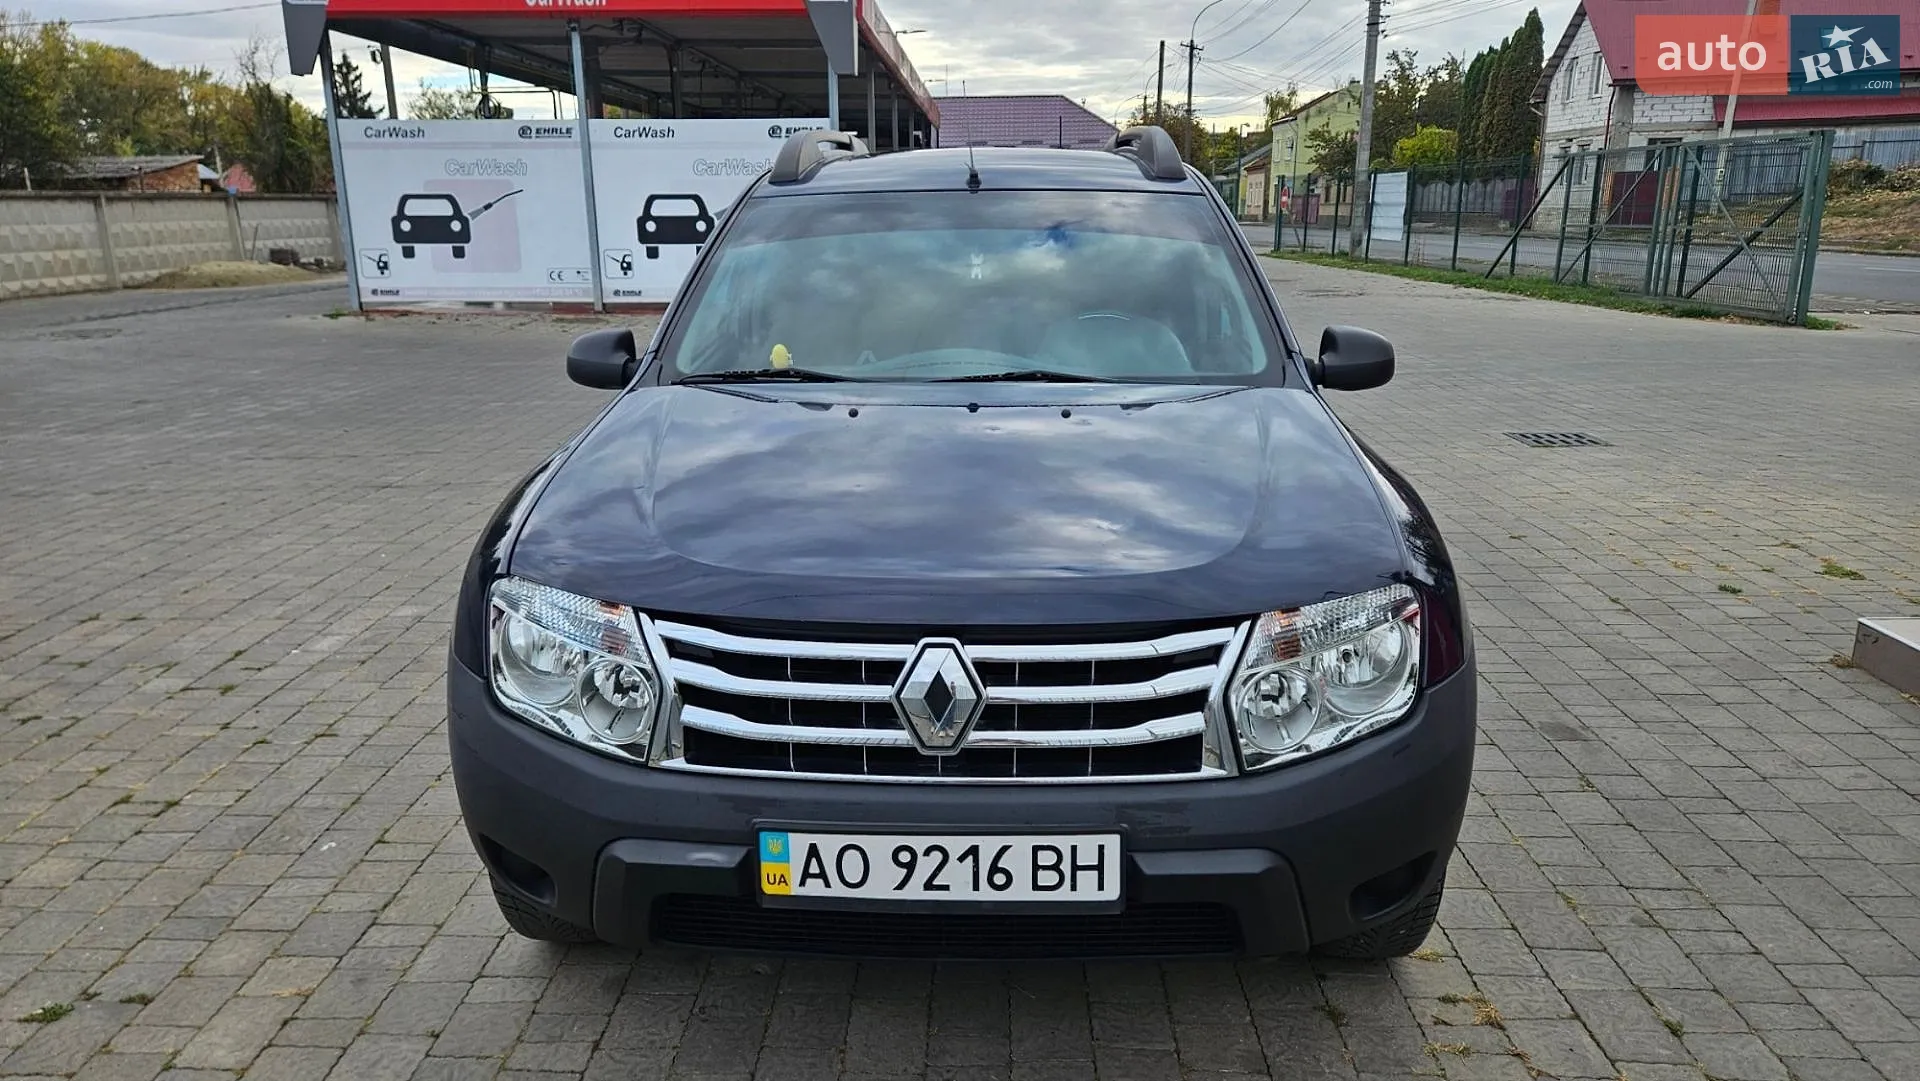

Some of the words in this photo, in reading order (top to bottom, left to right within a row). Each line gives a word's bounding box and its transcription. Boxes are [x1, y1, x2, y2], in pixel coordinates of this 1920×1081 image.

[363, 126, 426, 139] CarWash
[613, 126, 675, 139] CarWash
[444, 158, 528, 177] CarWash
[799, 842, 871, 889] AO
[890, 844, 1014, 892] 9216
[1031, 844, 1106, 892] BH
[765, 872, 789, 887] UA
